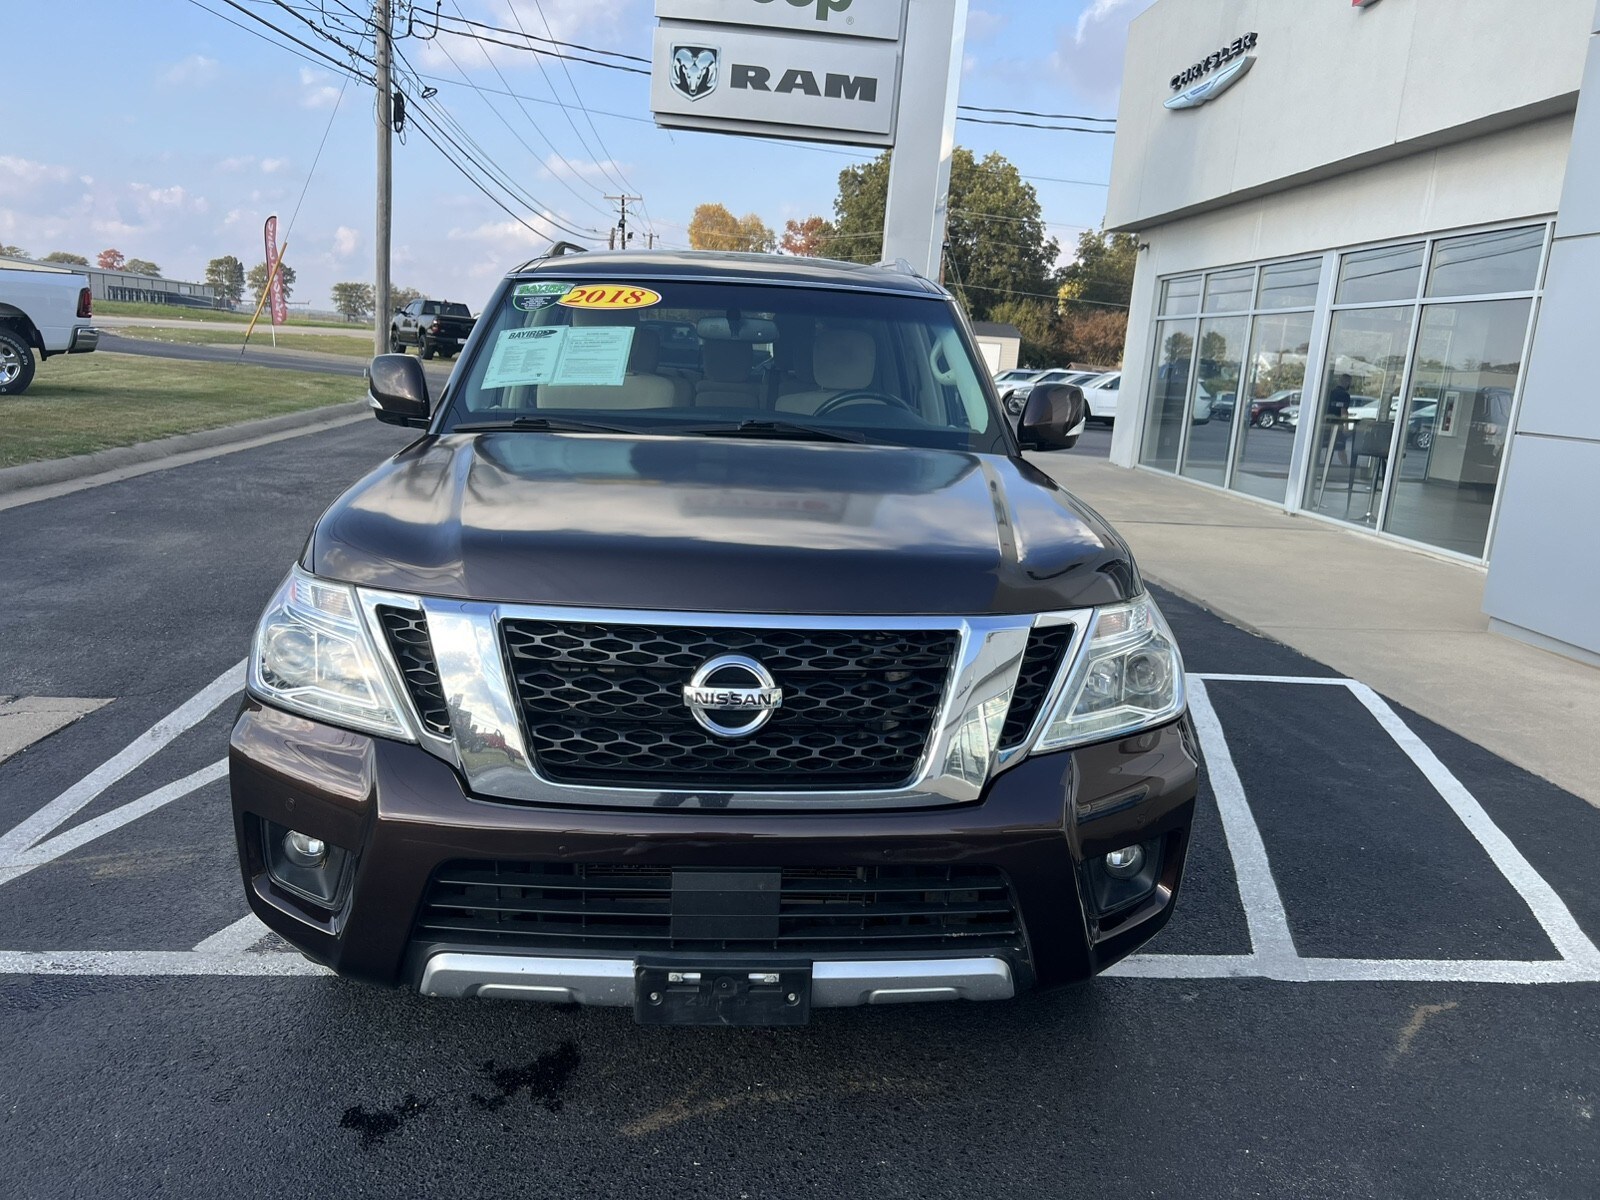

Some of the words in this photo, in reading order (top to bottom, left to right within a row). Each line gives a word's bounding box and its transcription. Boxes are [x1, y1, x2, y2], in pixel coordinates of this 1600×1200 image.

[1169, 31, 1259, 90] CHRYSLER
[730, 63, 878, 103] RAM
[566, 289, 646, 304] 2018
[508, 330, 545, 339] BAYIRD
[694, 692, 772, 705] NISSAN
